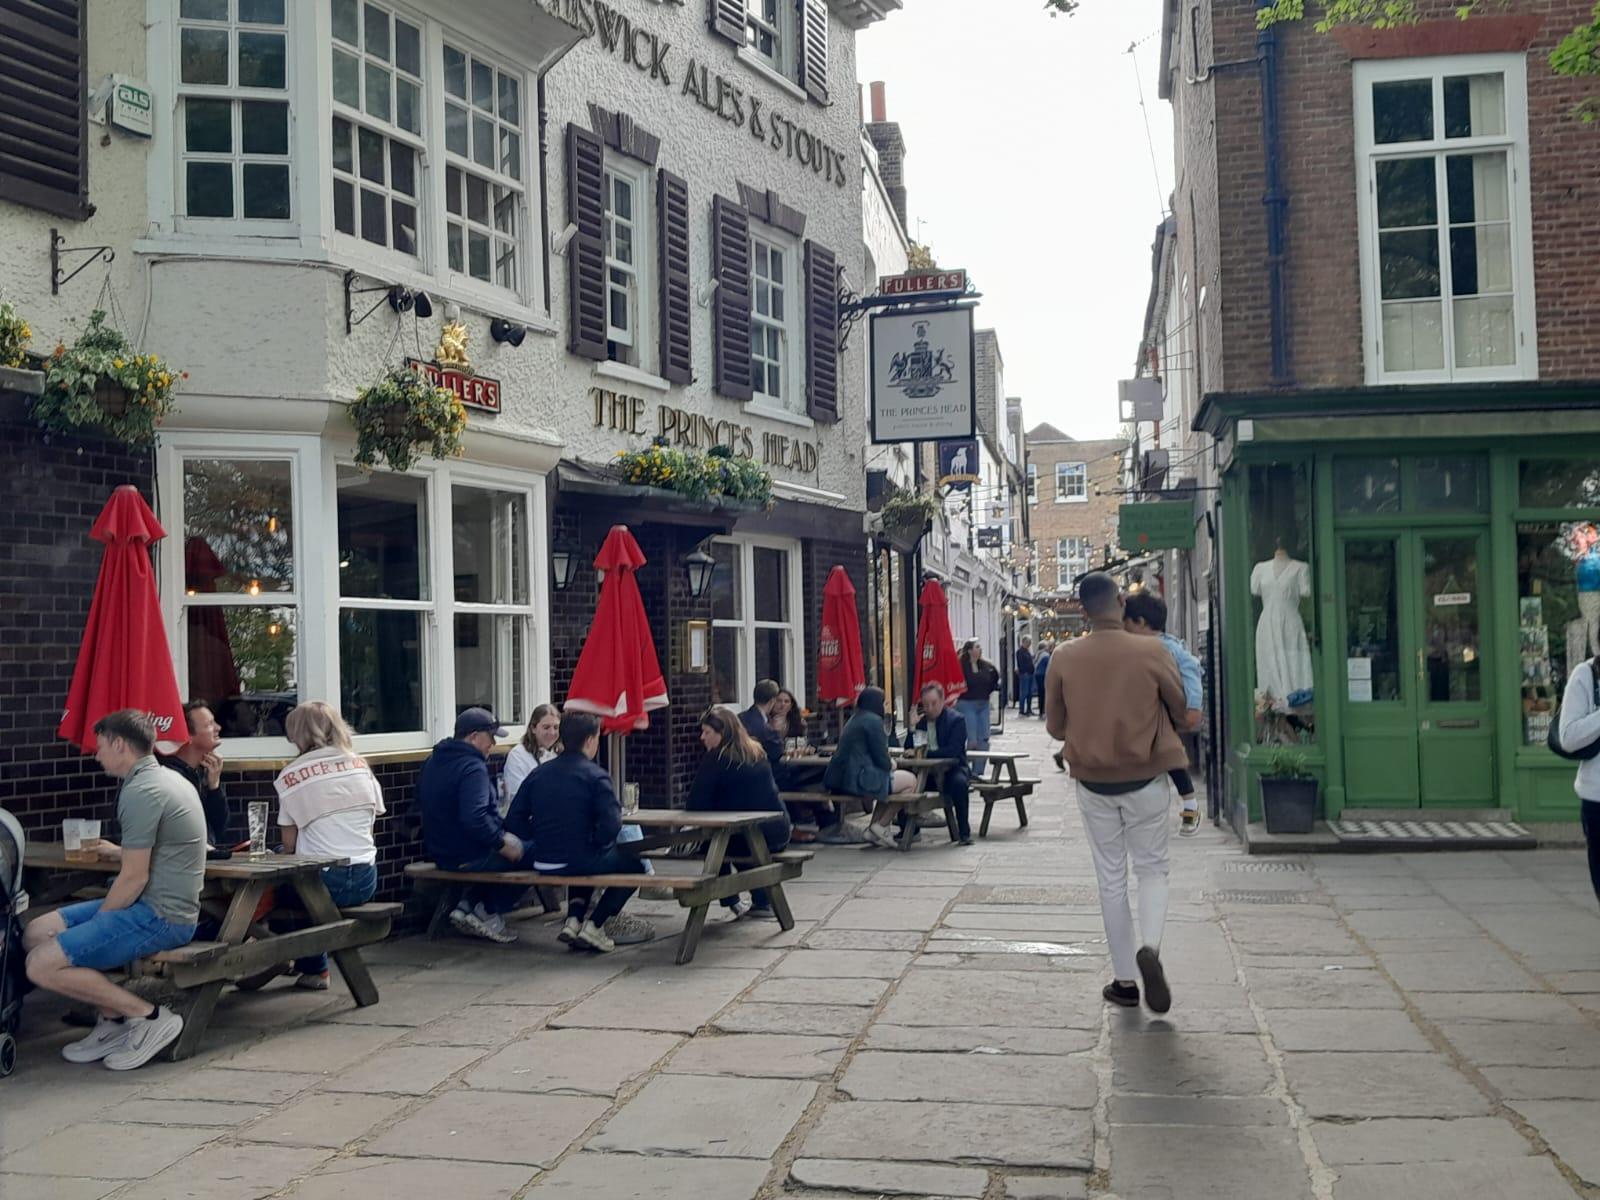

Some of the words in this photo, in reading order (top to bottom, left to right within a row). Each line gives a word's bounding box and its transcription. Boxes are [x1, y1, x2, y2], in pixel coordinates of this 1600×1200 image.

[682, 57, 745, 128] ALES
[749, 96, 765, 142] &
[770, 111, 847, 188] STOUTS
[588, 386, 647, 437] THE
[657, 404, 754, 461] PRINCES
[762, 431, 818, 474] HEAD
[880, 407, 898, 417] THE
[901, 404, 938, 417] PRINCES
[940, 403, 967, 414] HEAD
[1528, 730, 1549, 741] SHO
